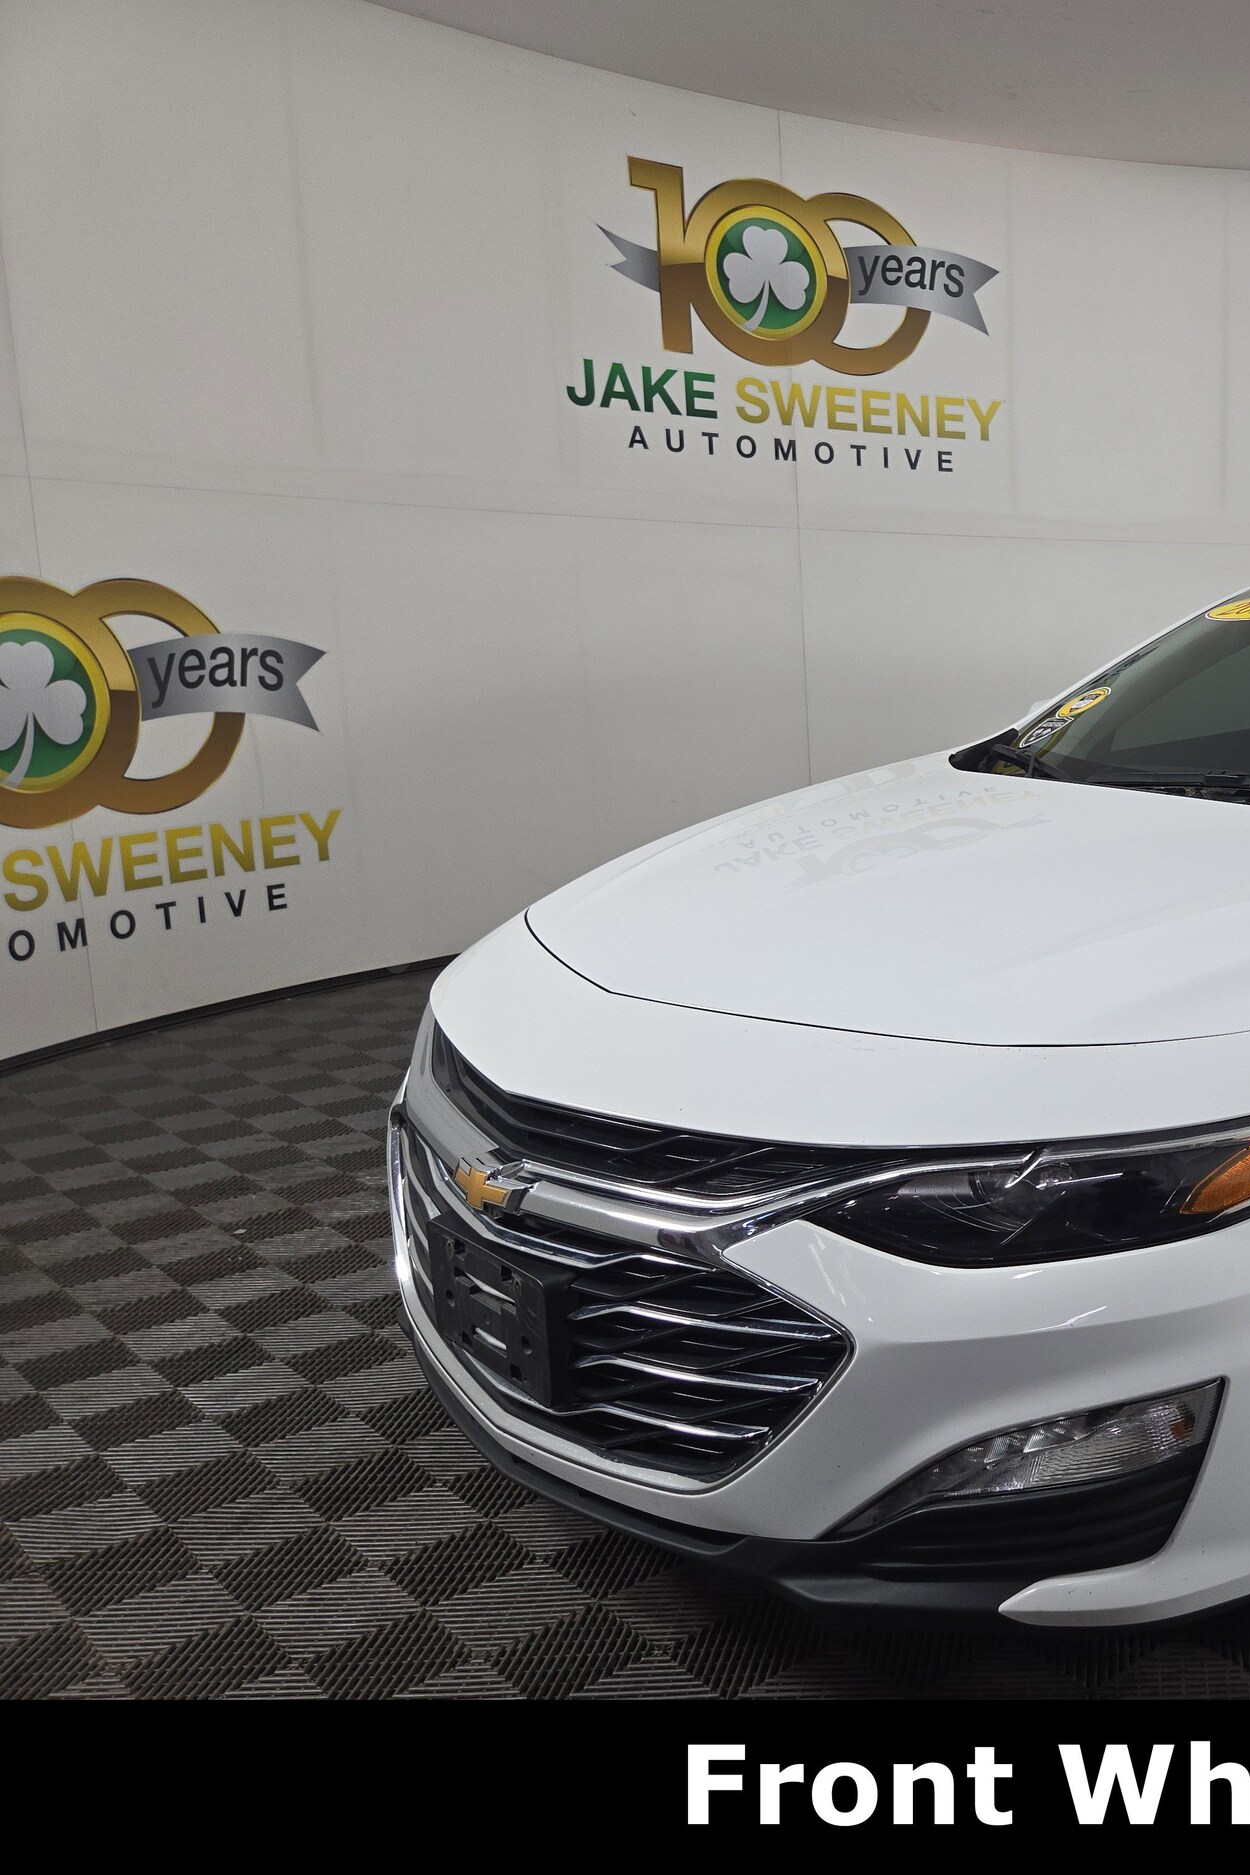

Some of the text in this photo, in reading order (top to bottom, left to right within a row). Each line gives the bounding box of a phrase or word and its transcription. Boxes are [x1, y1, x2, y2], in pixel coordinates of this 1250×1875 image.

[626, 156, 932, 376] 100
[857, 254, 966, 298] years
[566, 358, 1001, 442] JAKE SWEENEY
[628, 425, 955, 473] AUTOMOTIVE
[146, 645, 285, 709] years
[2, 808, 342, 912] SWEENEY
[8, 883, 288, 962] OMOTIVE
